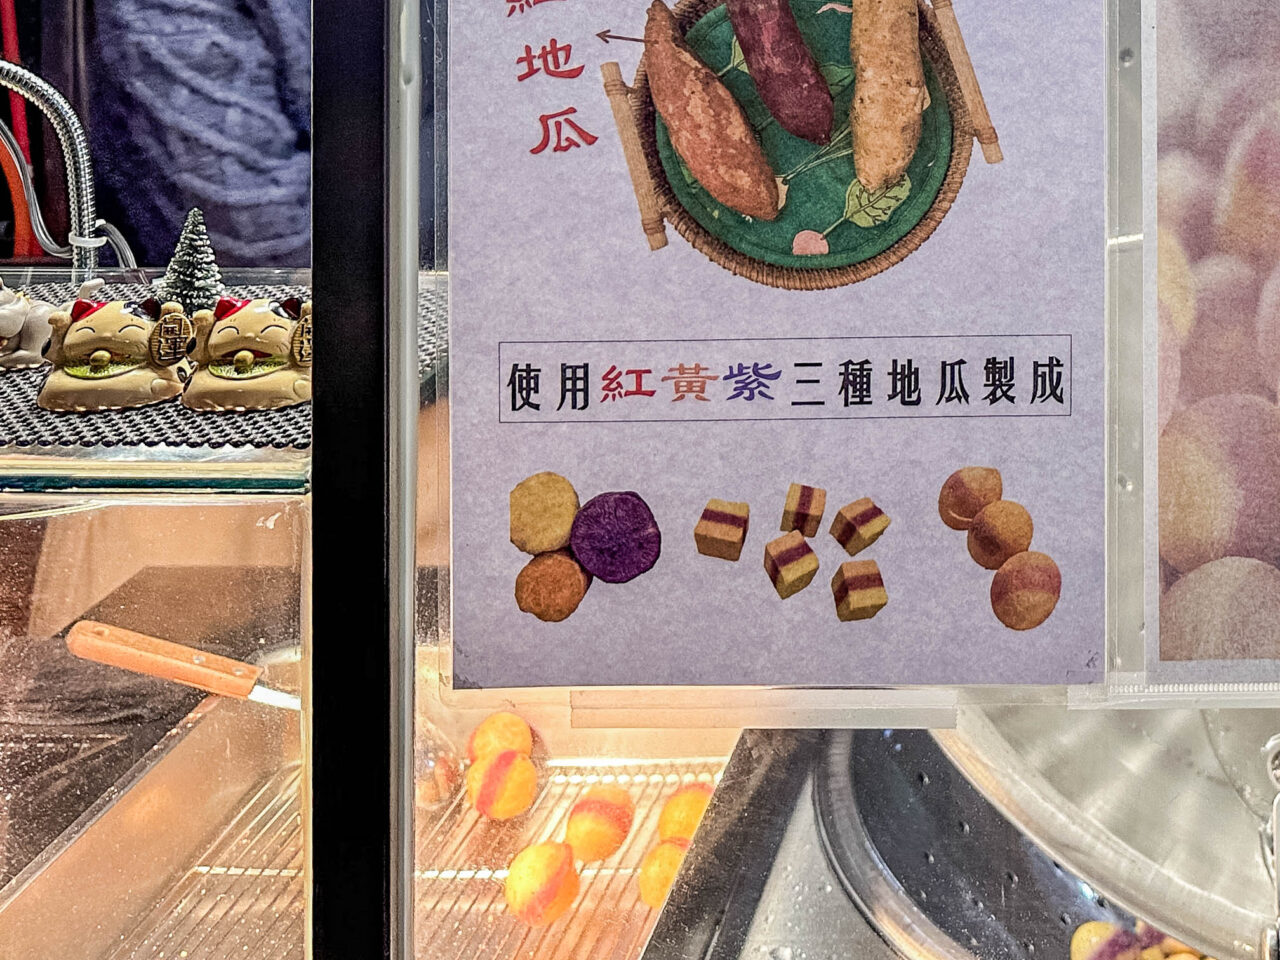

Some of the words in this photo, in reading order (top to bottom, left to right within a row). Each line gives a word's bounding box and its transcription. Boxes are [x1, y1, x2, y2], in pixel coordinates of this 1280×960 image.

[506, 355, 1066, 412] 使用紅黃紫三種地瓜製成
